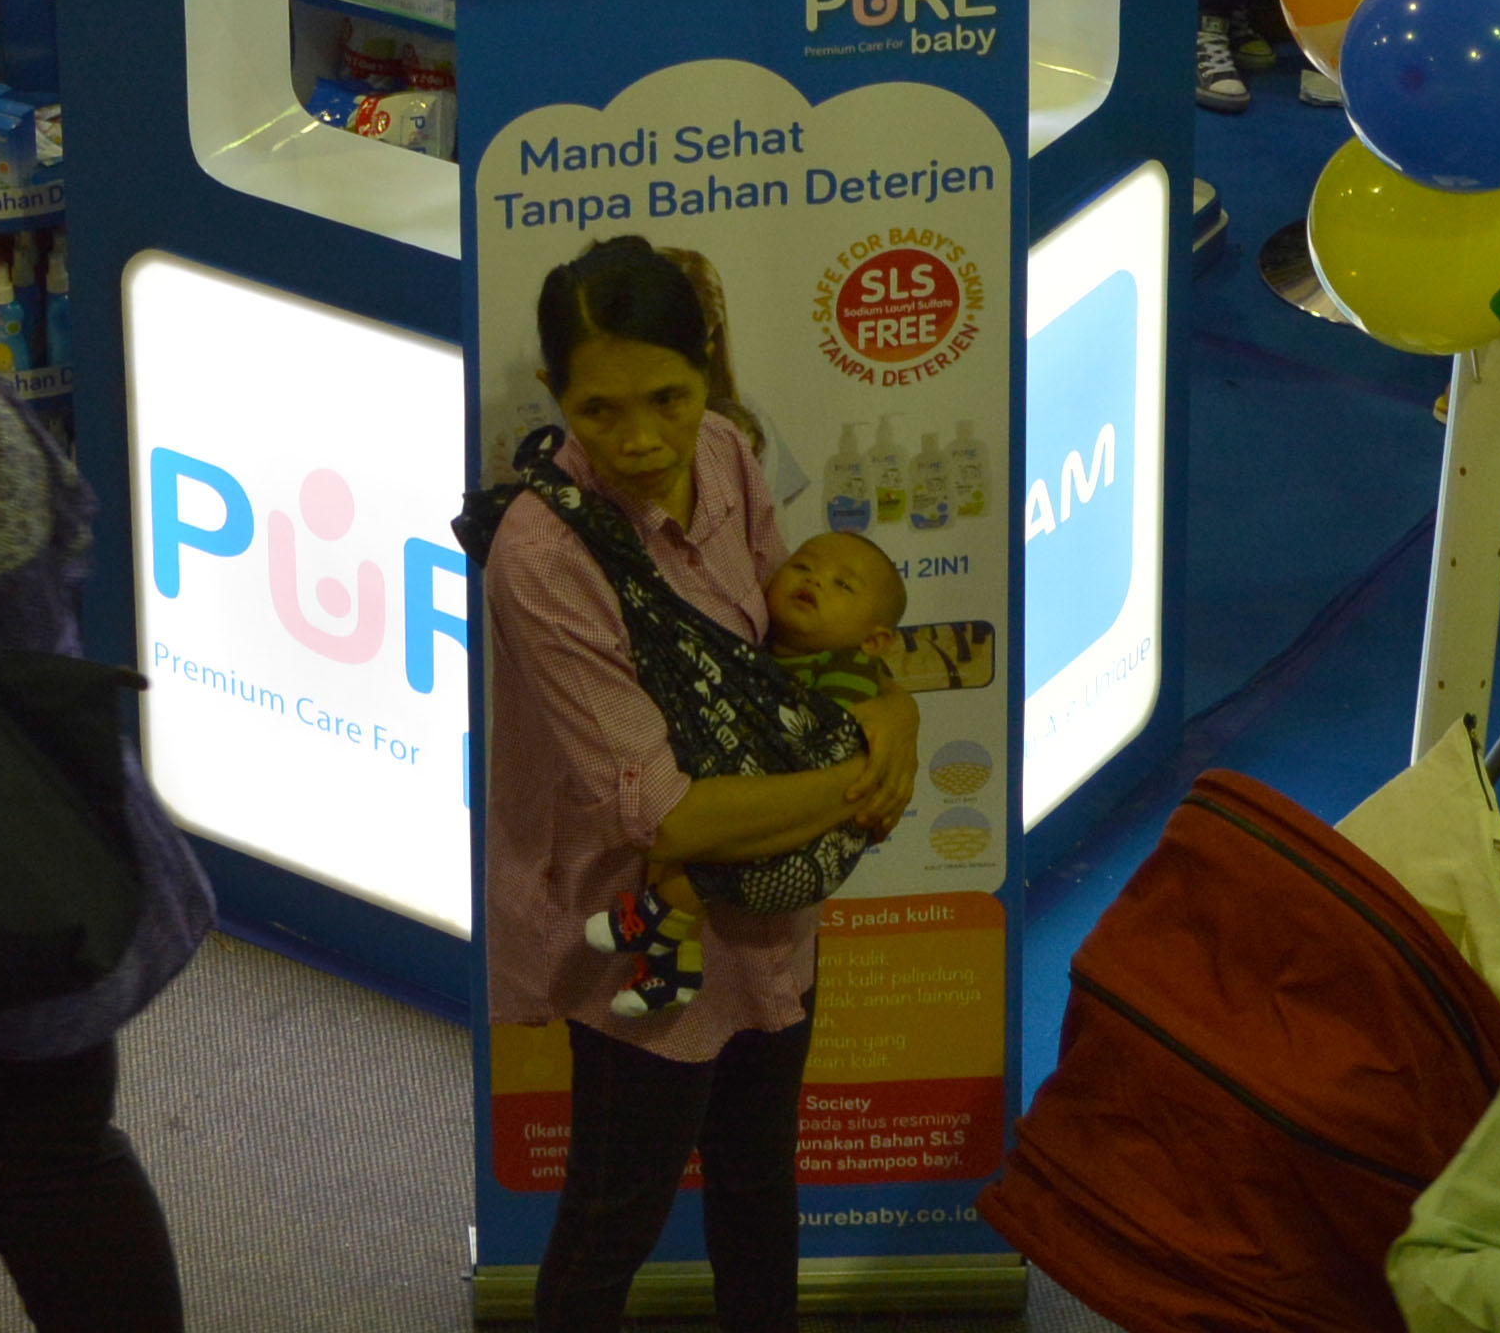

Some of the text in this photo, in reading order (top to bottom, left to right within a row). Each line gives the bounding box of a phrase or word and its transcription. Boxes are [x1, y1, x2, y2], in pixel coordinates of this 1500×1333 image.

[909, 22, 997, 59] baby
[518, 118, 804, 178] Mandi Sehat
[494, 155, 995, 233] Tanpa Bahan Deterjen
[812, 227, 966, 322] SAFE FOR BABY'S
[860, 263, 936, 304] SLS
[843, 305, 883, 319] Sodium
[857, 313, 938, 350] FREE
[818, 322, 982, 387] TANPA DETERJEN
[917, 554, 970, 580] 2IN1
[150, 637, 421, 766] Premium Care For
[850, 904, 956, 930] pada kulit:
[916, 987, 982, 1006] lainnya
[805, 1094, 872, 1113] Society
[799, 1109, 971, 1134] pada situs resminya
[869, 1130, 965, 1149] Bahan SLS
[799, 1151, 963, 1173] dan shampoo bayi.
